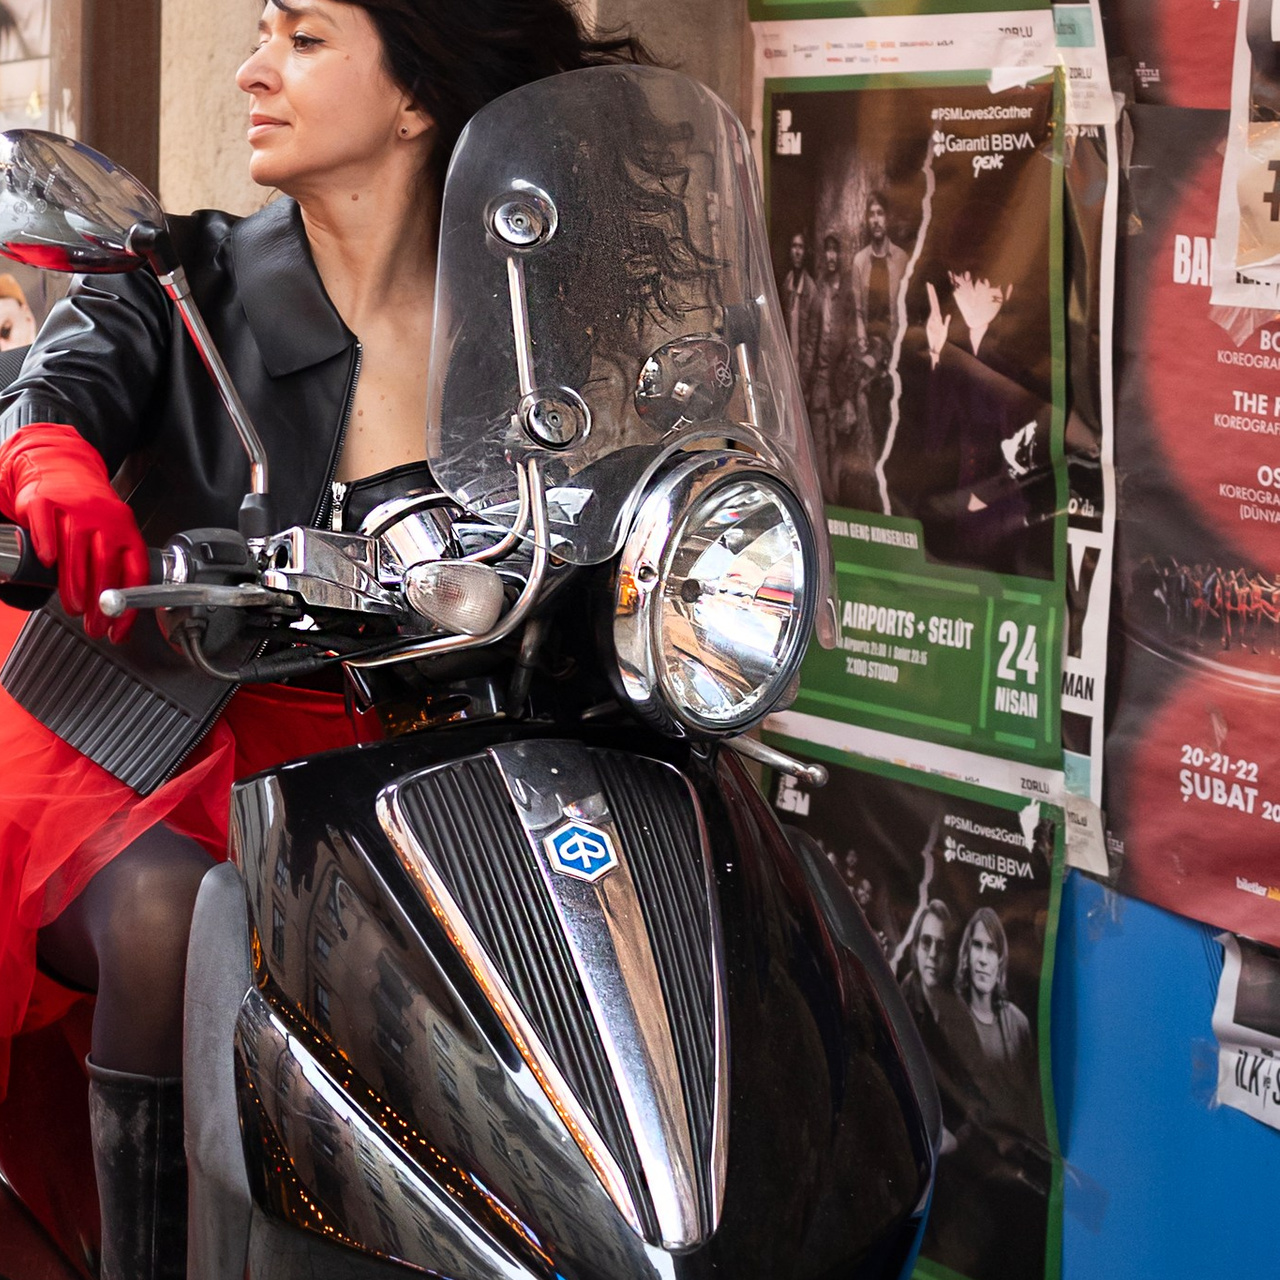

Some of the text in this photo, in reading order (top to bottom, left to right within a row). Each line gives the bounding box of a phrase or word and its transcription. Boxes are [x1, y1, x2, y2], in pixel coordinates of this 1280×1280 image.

[931, 106, 1033, 122] #PSMLoves2Gather
[945, 132, 1035, 152] Garanti BBVA
[1173, 233, 1216, 287] BA
[1232, 389, 1269, 416] THE
[842, 600, 916, 639] AIRPORTS
[996, 620, 1039, 685] 24
[869, 662, 899, 683] STUDIO
[1180, 743, 1259, 783] 20-21-22
[1020, 776, 1050, 795] ZORLU
[1179, 768, 1259, 815] ŞUBAT
[956, 844, 1034, 880] Garanti BBVA
